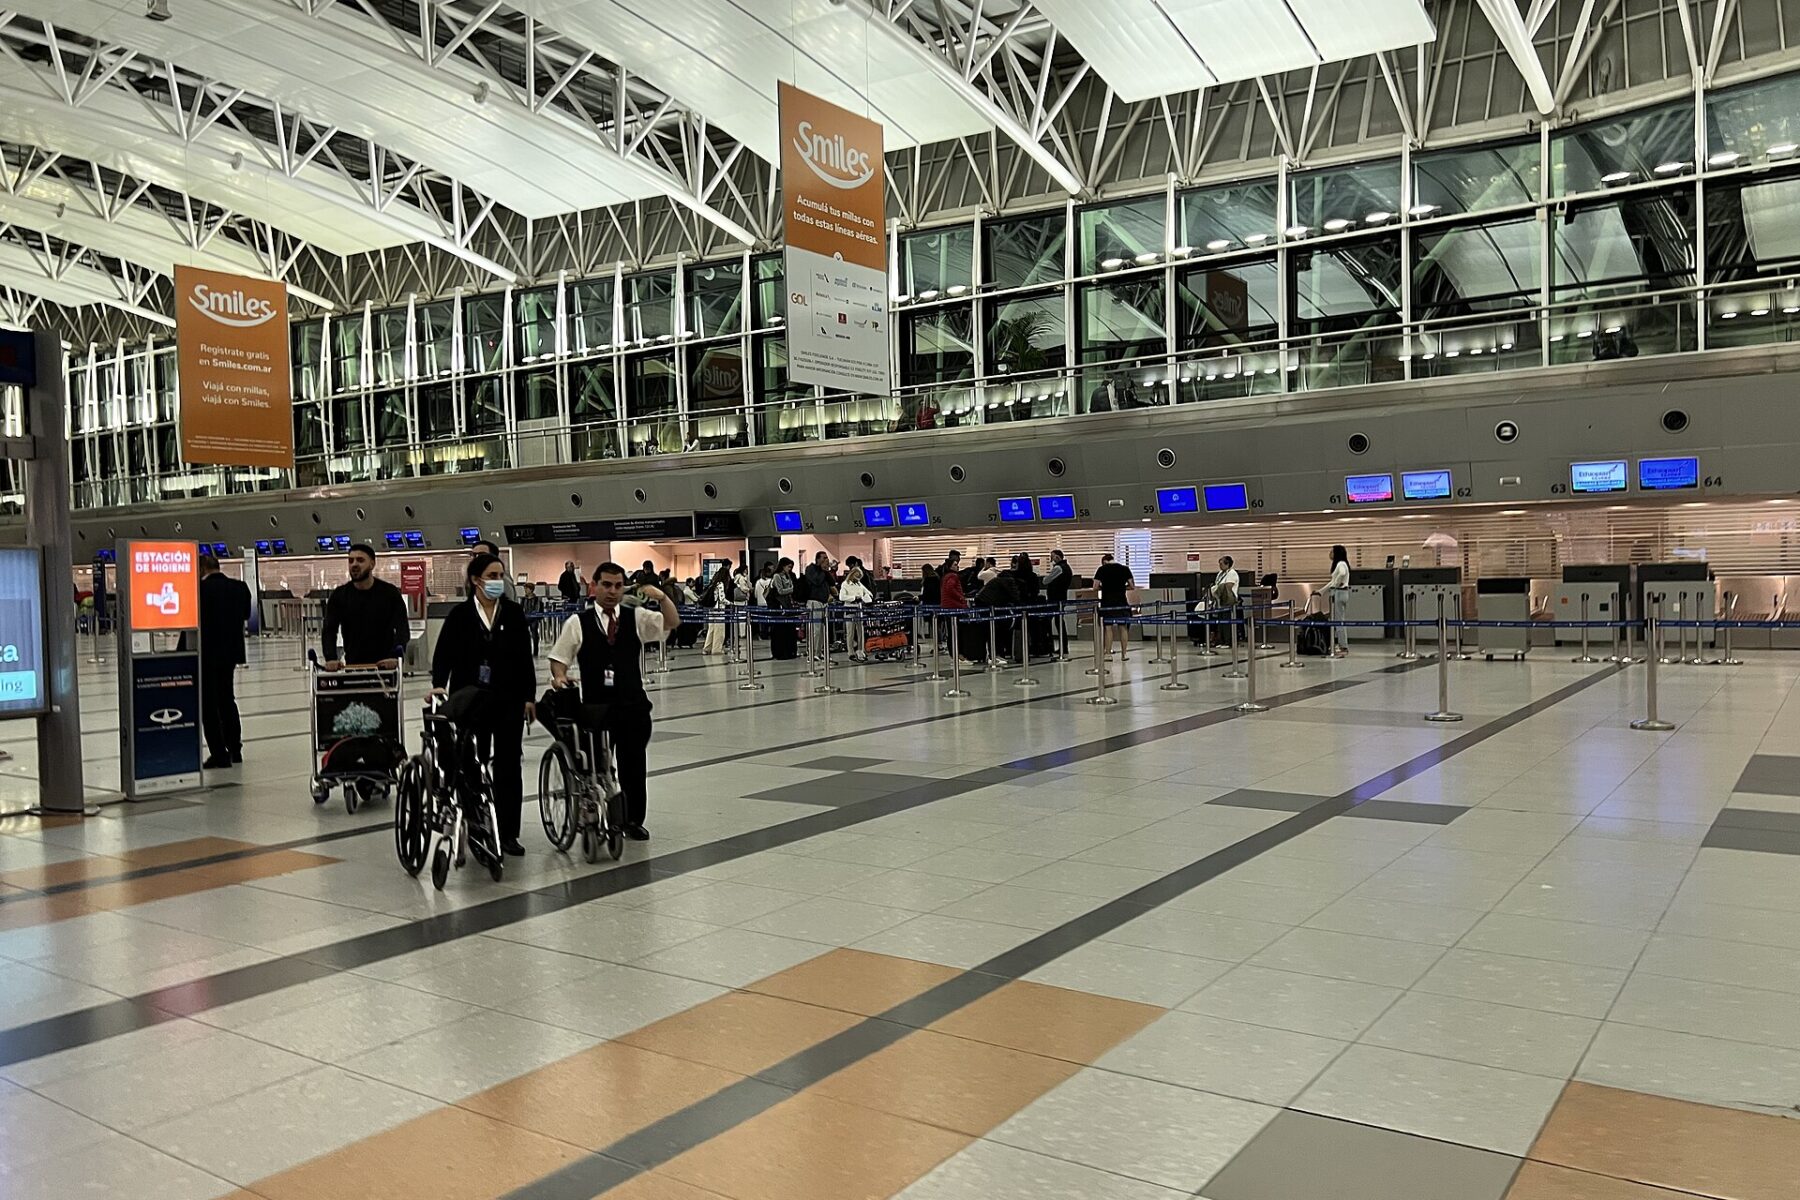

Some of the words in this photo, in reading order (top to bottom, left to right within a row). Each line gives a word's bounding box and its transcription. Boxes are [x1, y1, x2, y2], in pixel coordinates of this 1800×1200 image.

[796, 121, 873, 181] Smiles
[797, 194, 829, 214] Acumulá
[829, 206, 841, 217] tus
[842, 210, 862, 224] millas
[862, 218, 875, 228] con
[793, 211, 814, 225] todas
[815, 219, 834, 231] estas
[834, 222, 855, 238] líneas
[855, 229, 879, 245] aéreas.
[191, 284, 275, 320] Smiles
[791, 292, 808, 306] GOL
[200, 343, 245, 358] Registrate
[246, 350, 270, 361] gratis
[199, 358, 210, 366] en
[212, 359, 272, 374] Smiles.com.ar
[202, 380, 224, 392] Viajá
[226, 384, 242, 393] con
[243, 386, 270, 397] millas,
[202, 394, 222, 405] viajá
[224, 397, 240, 406] con
[241, 398, 272, 409] Smiles.
[1704, 477, 1722, 487] 64
[1457, 487, 1472, 498] 62
[1551, 484, 1566, 494] 63
[1251, 499, 1264, 508] 60
[1329, 494, 1341, 504] 61
[1079, 509, 1090, 517] 58
[1143, 505, 1154, 514] 59
[932, 516, 942, 524] 56
[988, 514, 997, 522] 57
[805, 522, 814, 531] 54
[854, 520, 863, 528] 55
[135, 550, 191, 563] ESTACIÓN
[135, 562, 150, 573] DE
[151, 562, 191, 573] HIGIENE
